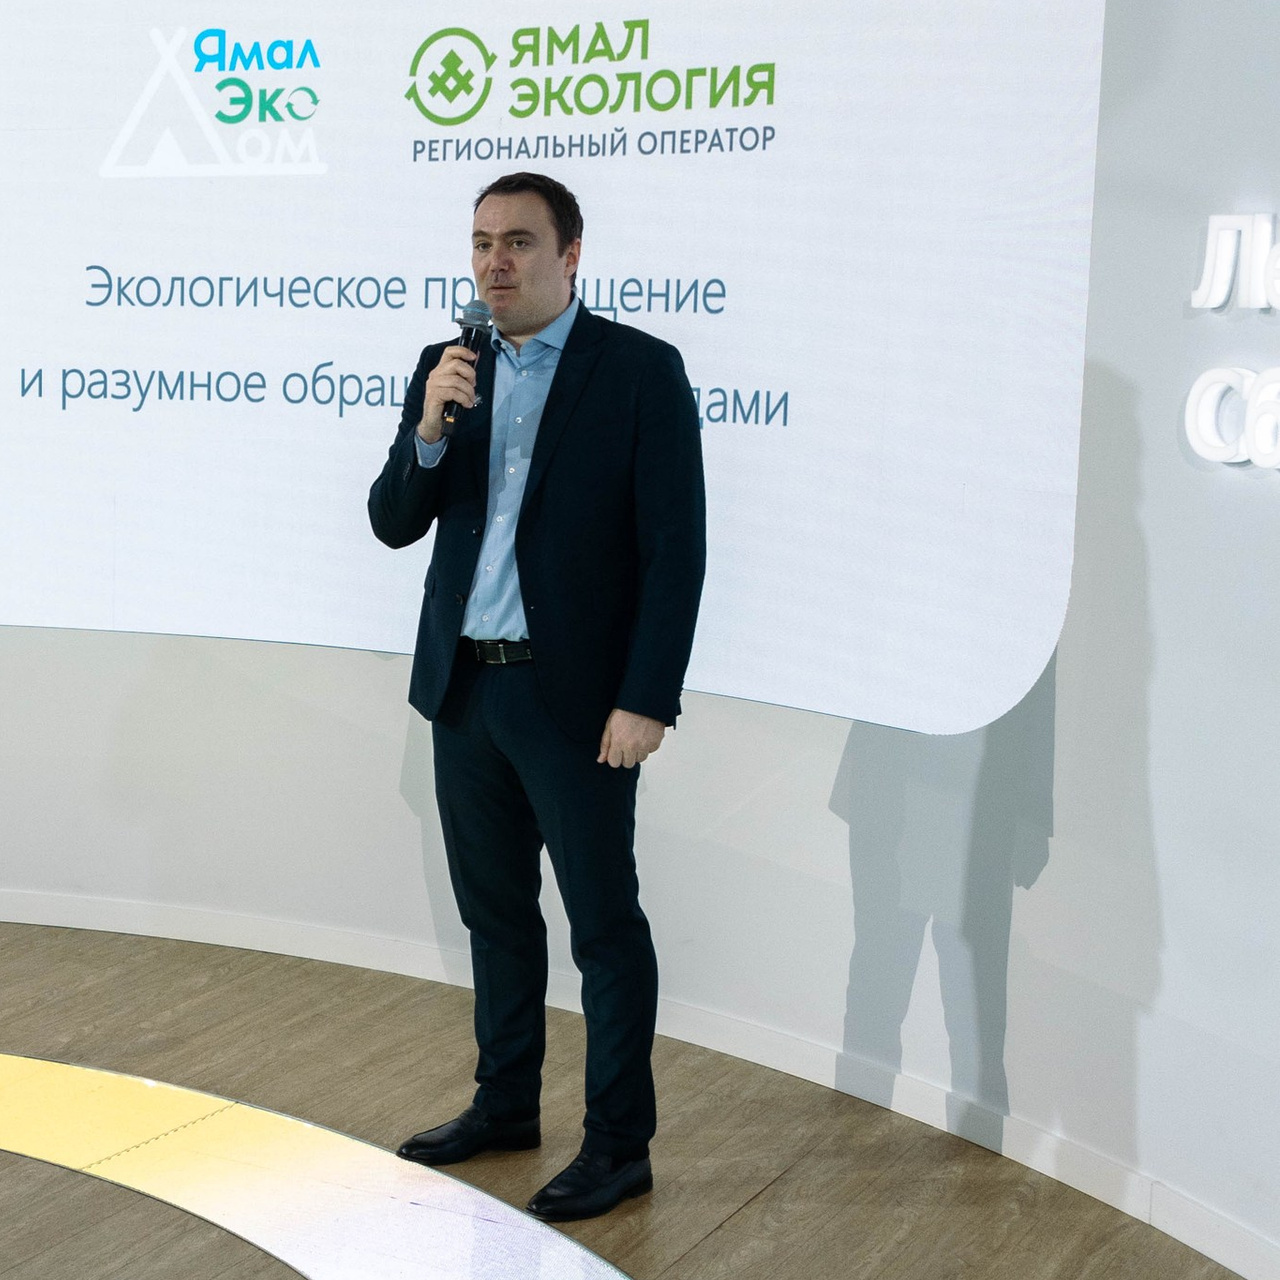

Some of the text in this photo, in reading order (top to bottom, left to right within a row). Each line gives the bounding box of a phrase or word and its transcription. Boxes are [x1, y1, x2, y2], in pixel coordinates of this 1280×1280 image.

[193, 28, 321, 73] Ямал
[509, 19, 650, 68] ЯМАЛ
[508, 62, 777, 119] ЭКОЛОГИЯ
[412, 125, 776, 163] РЕГИОНАЛЬНЫЙ ОПЕРАТОР
[85, 264, 728, 323] Экологическое прщение
[20, 368, 44, 398] и
[61, 368, 267, 413] разумное
